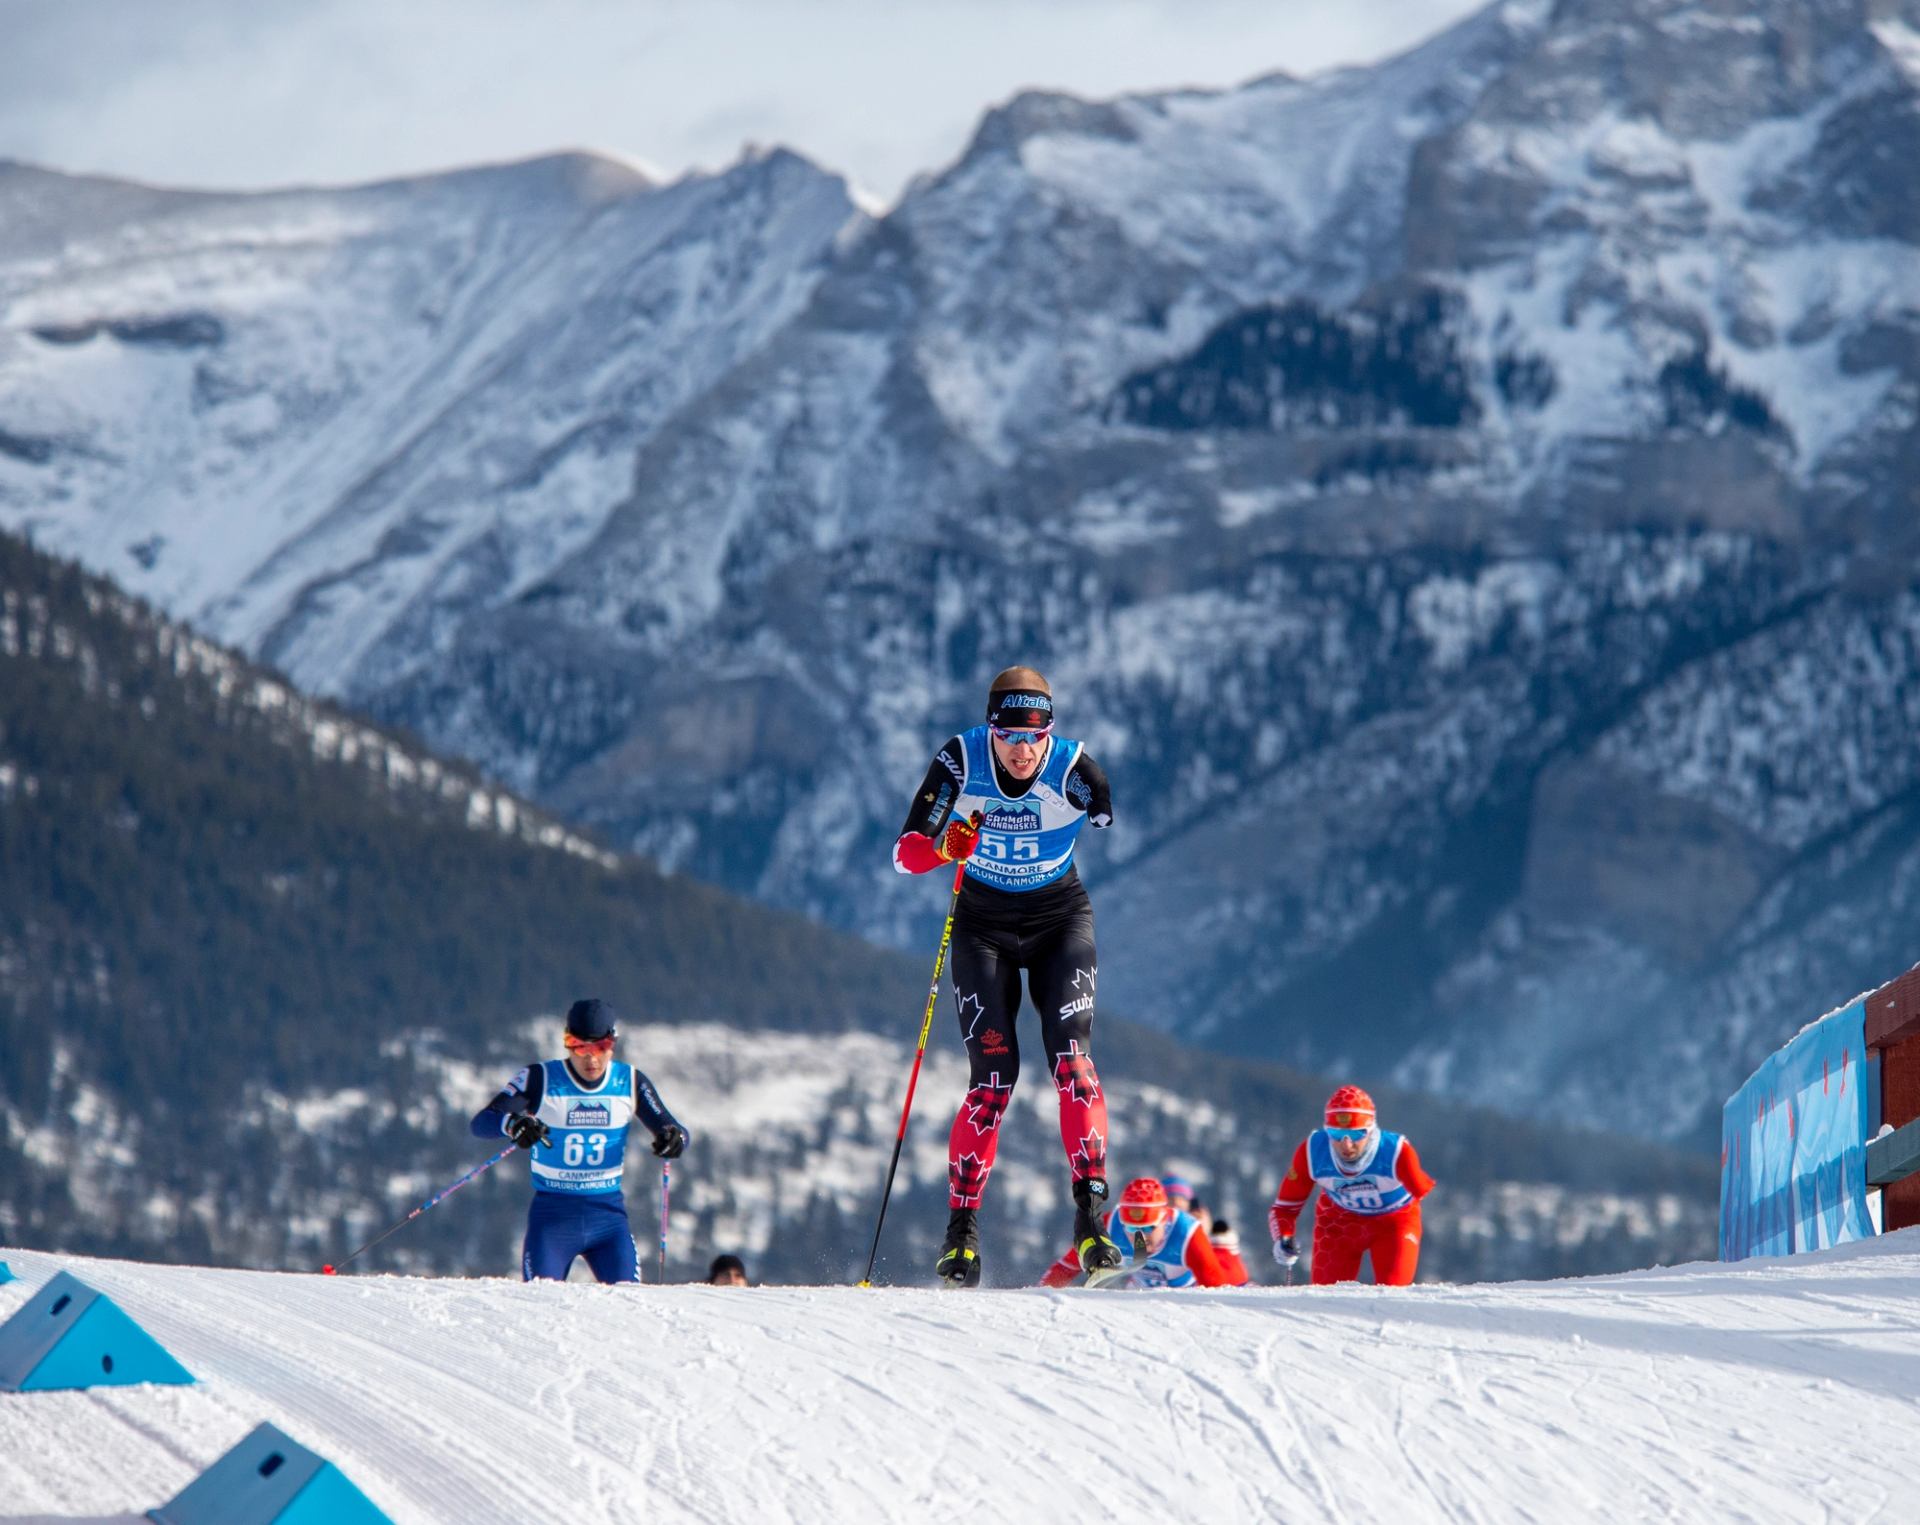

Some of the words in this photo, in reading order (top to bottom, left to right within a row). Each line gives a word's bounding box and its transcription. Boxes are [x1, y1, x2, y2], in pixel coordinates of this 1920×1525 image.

[936, 750, 964, 789] swi
[985, 821, 1038, 830] KANANASKIS
[986, 814, 1038, 823] CANMORE
[981, 833, 1039, 860] 55
[1059, 993, 1093, 1020] swix
[569, 1111, 608, 1119] CANMORE
[563, 1133, 607, 1167] 63
